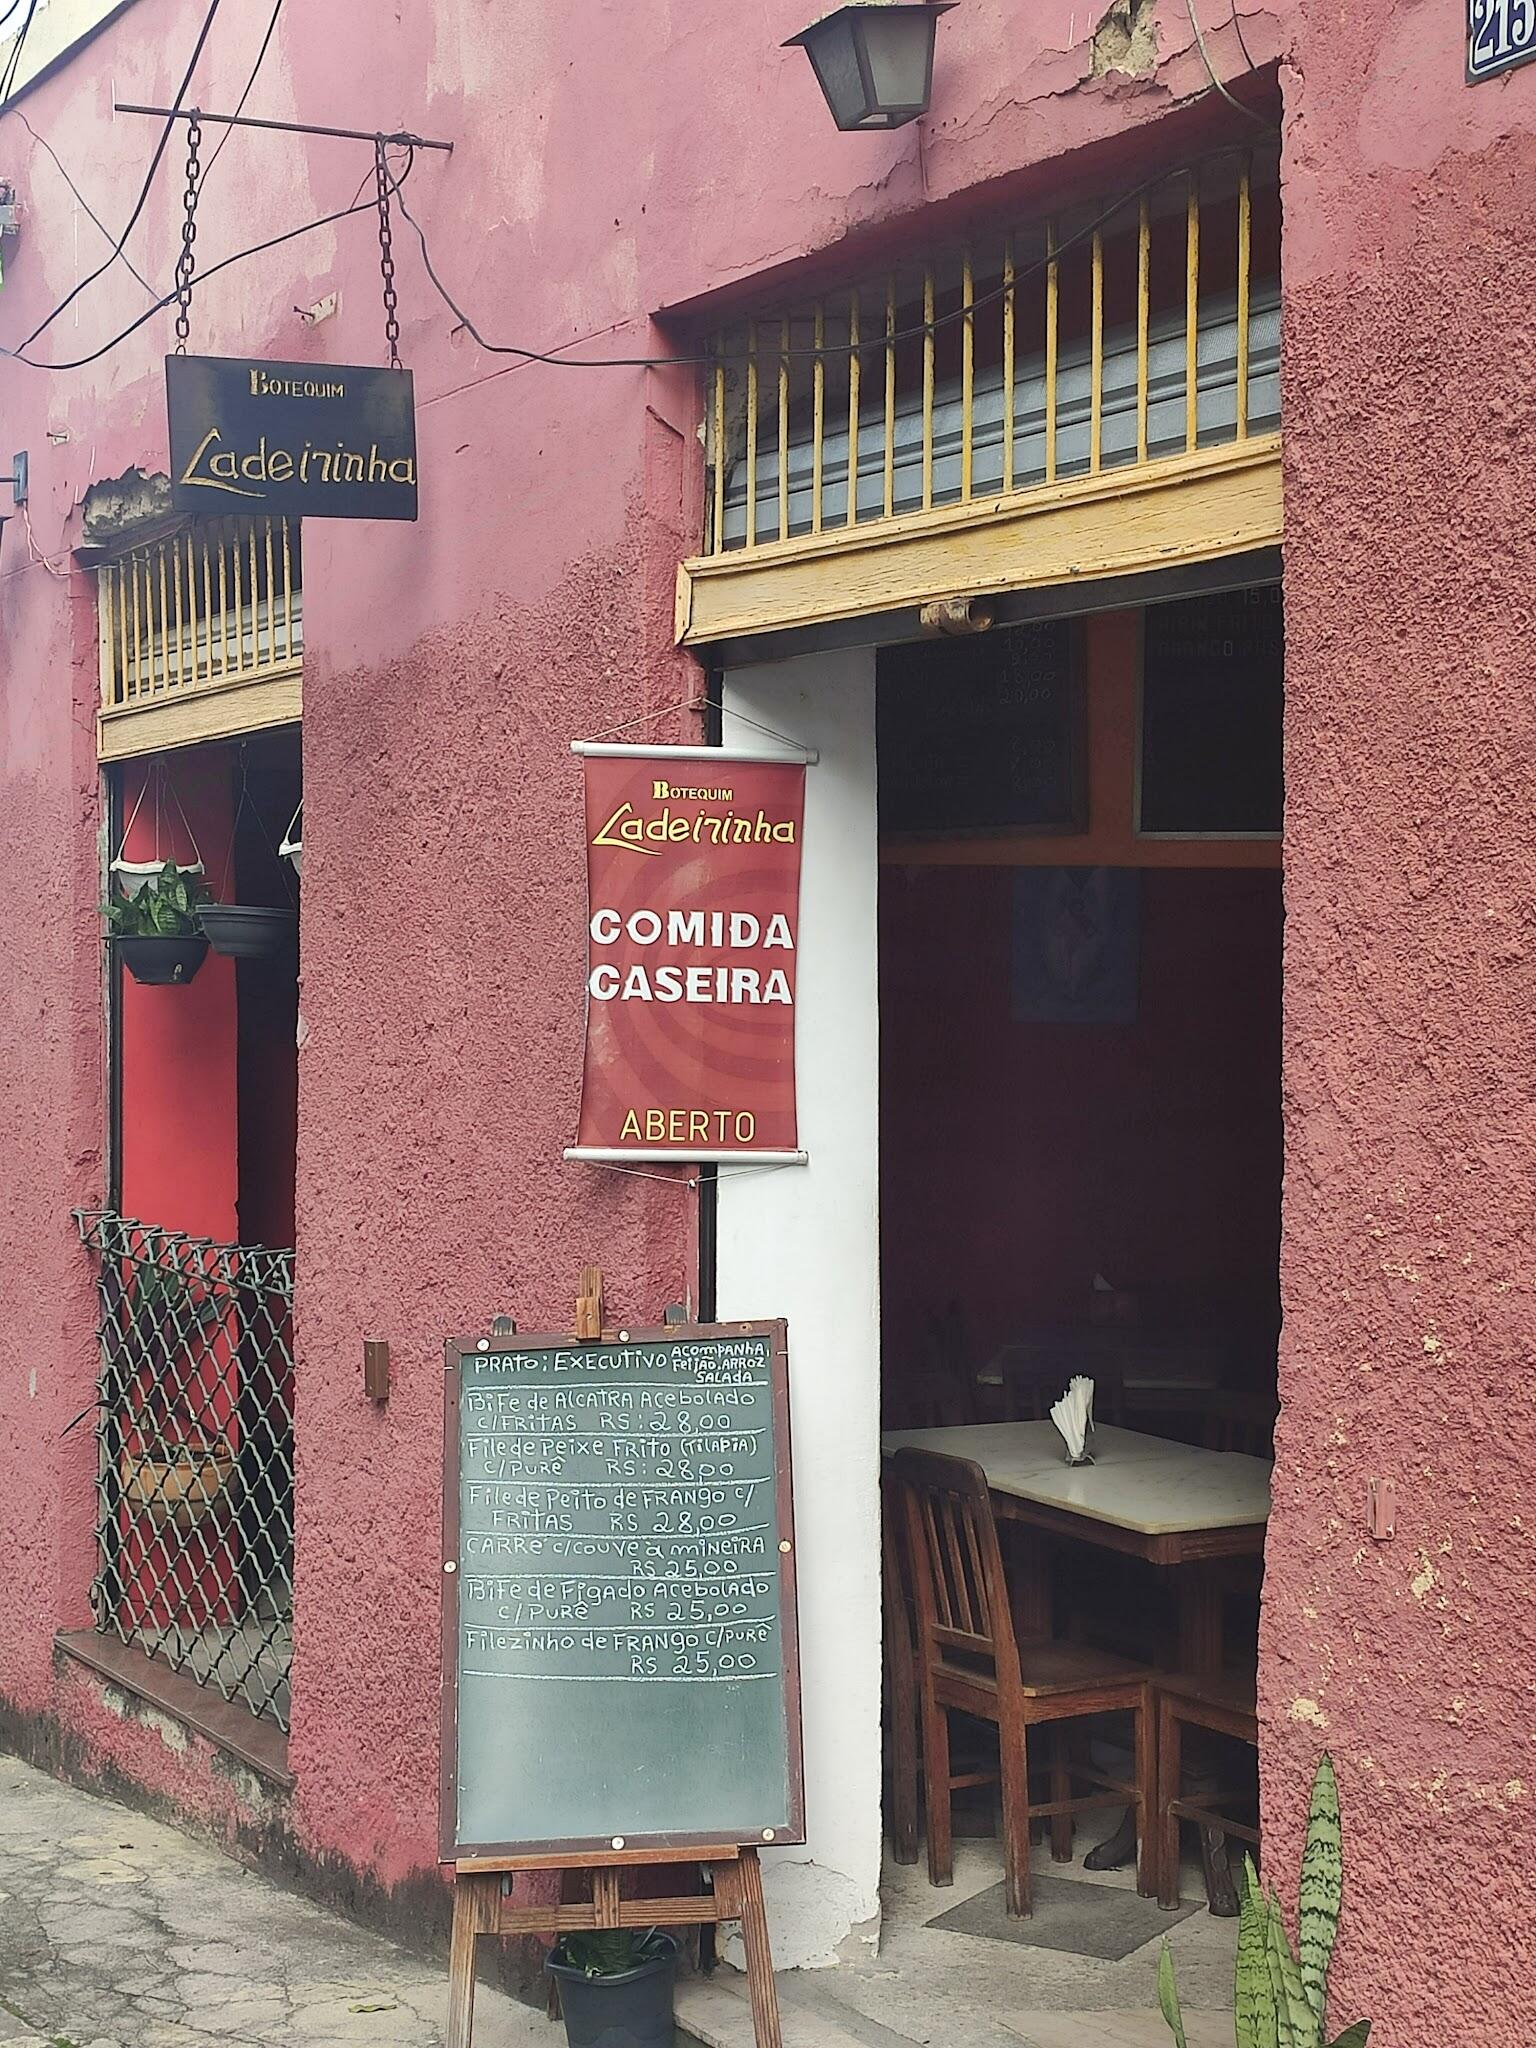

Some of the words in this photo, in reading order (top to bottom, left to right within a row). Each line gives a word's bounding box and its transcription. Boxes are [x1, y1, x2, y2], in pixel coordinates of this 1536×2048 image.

[1474, 0, 1536, 64] 215
[249, 368, 345, 398] BOTEQUIM
[179, 427, 416, 498] Ladeirinha
[652, 780, 733, 801] BOTEQUIM
[592, 802, 795, 856] Ladeirinha
[589, 908, 794, 949] COMIDA
[589, 965, 793, 1005] CASEIRA
[620, 1109, 755, 1142] ABERTO
[527, 1392, 548, 1411] de
[650, 1410, 731, 1434] 28,00
[614, 1488, 637, 1509] de
[653, 1511, 737, 1537] 28,00
[665, 1560, 738, 1579] 25,00
[528, 1579, 556, 1601] de
[667, 1600, 747, 1622] 25,00
[581, 1631, 607, 1651] de
[673, 1650, 756, 1677] 25,00
